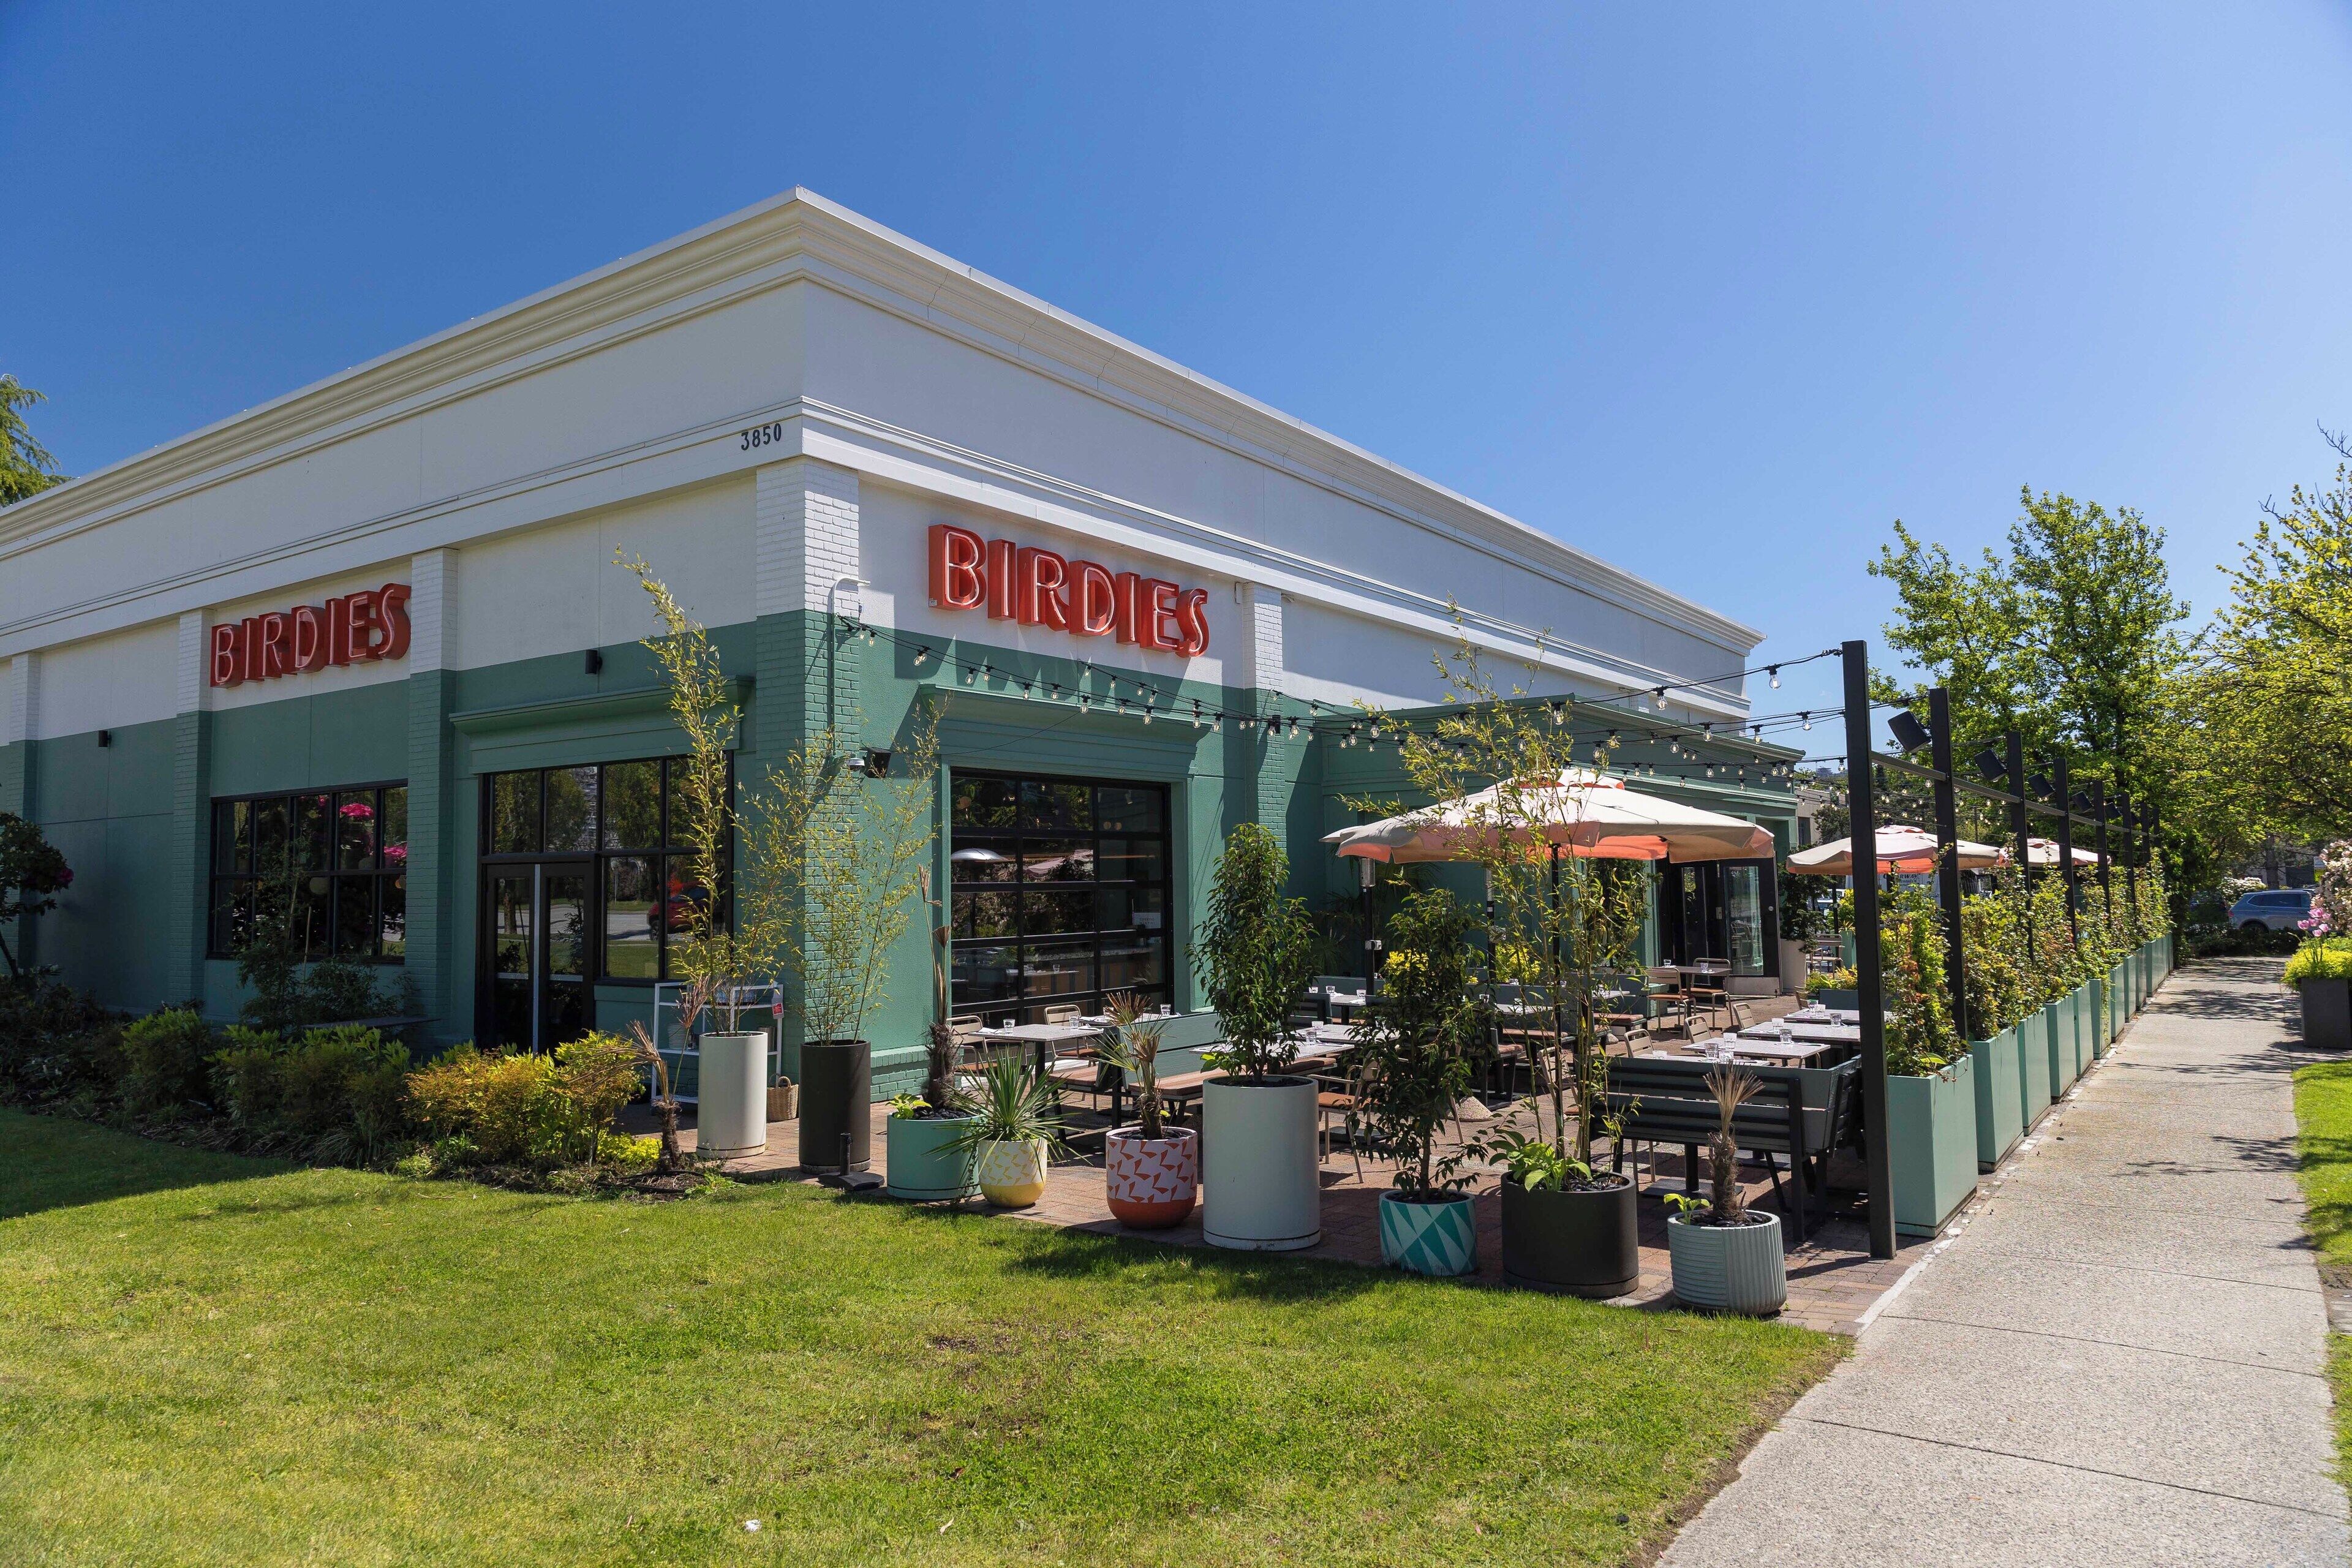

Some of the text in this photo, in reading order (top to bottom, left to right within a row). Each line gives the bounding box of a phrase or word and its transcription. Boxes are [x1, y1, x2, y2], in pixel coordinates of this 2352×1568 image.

[741, 423, 782, 451] 3850
[210, 582, 412, 688] BIRDIES
[928, 524, 1210, 658] BIRDIES
